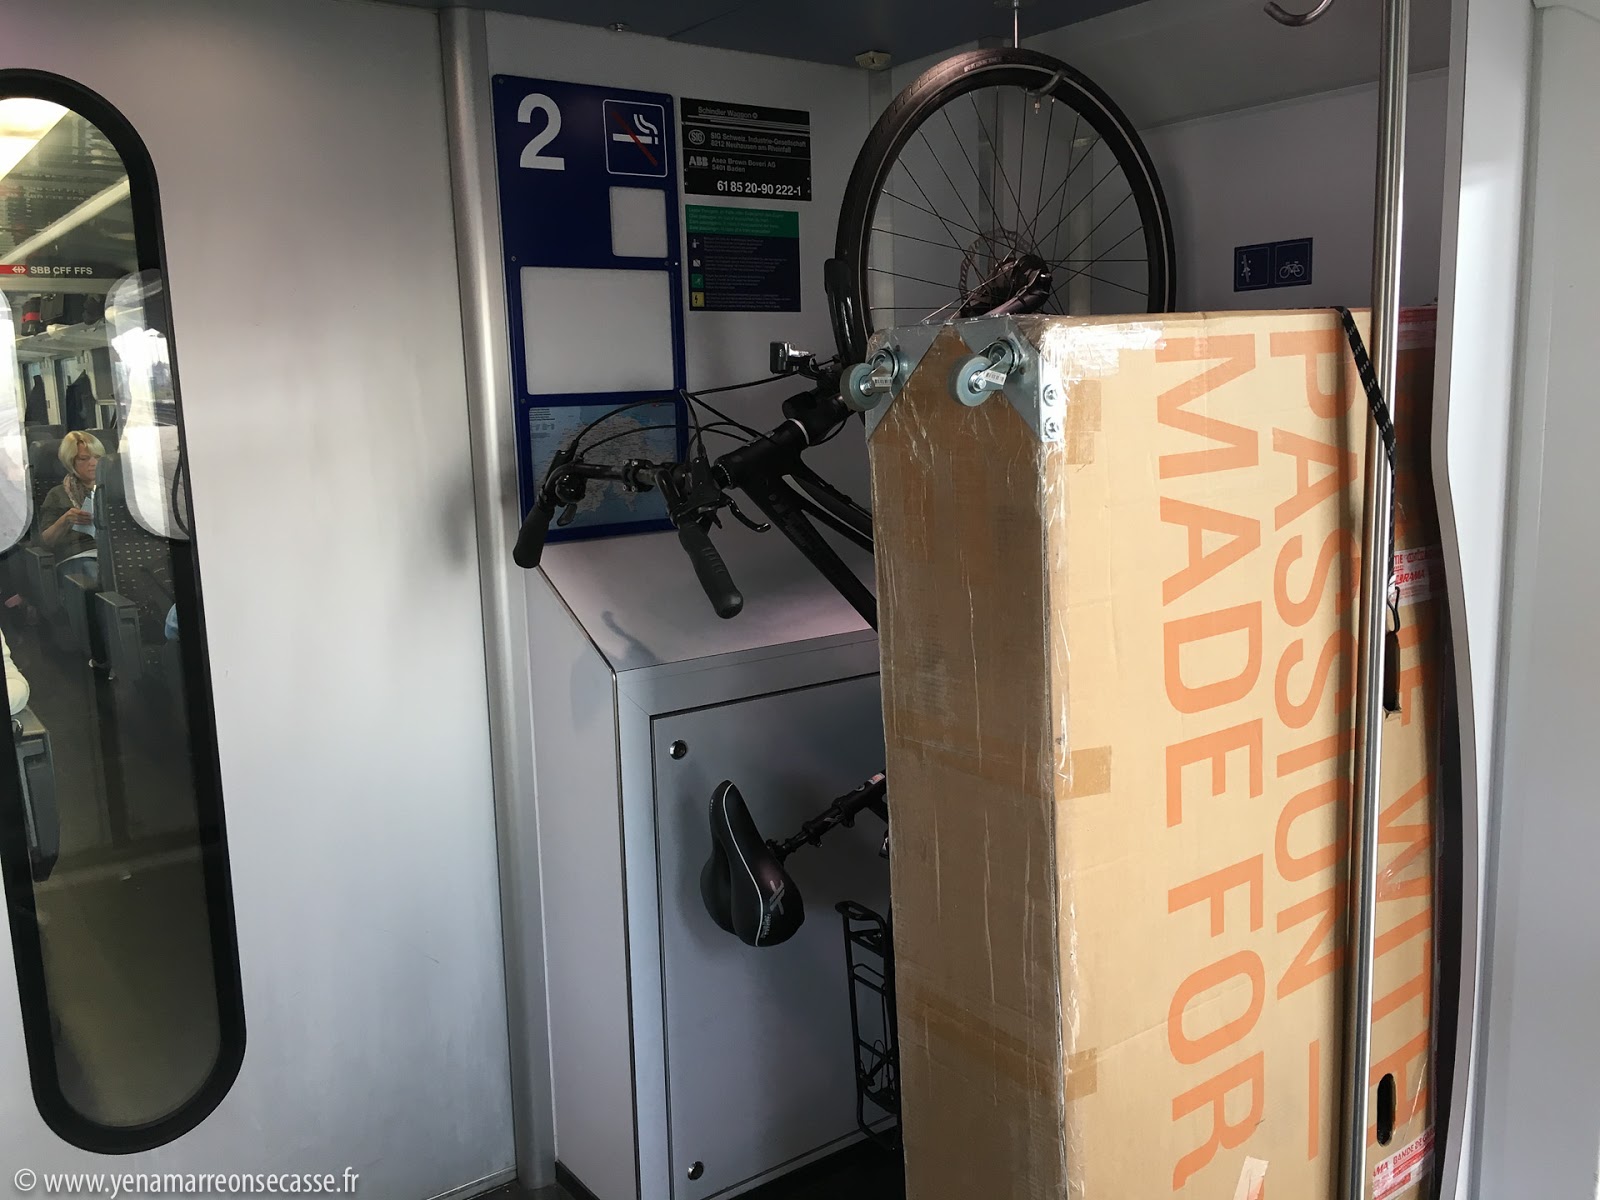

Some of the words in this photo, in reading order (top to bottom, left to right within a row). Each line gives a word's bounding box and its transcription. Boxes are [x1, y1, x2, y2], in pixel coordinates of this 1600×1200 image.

[698, 106, 726, 116] Schindler
[727, 109, 752, 119] Waggon
[516, 92, 565, 171] 2
[690, 130, 704, 144] SIG
[710, 132, 722, 140] SIG
[747, 135, 807, 148] Industrie-Gesellschaft
[710, 139, 725, 147] 8212
[725, 140, 758, 151] Neuhausen
[767, 145, 792, 154] Rheinfall
[688, 155, 709, 167] ABB
[711, 156, 727, 164] Asea
[748, 159, 767, 167] Boveri
[726, 165, 746, 173] Baden
[716, 180, 728, 192] 61
[730, 181, 743, 193] 85
[745, 182, 774, 195] 20-90
[775, 184, 801, 196] 222-1
[30, 265, 51, 274] SBB
[52, 266, 72, 275] CFF
[74, 266, 93, 275] FFS
[1154, 332, 1264, 828] MADE
[1166, 852, 1266, 1192] FOR
